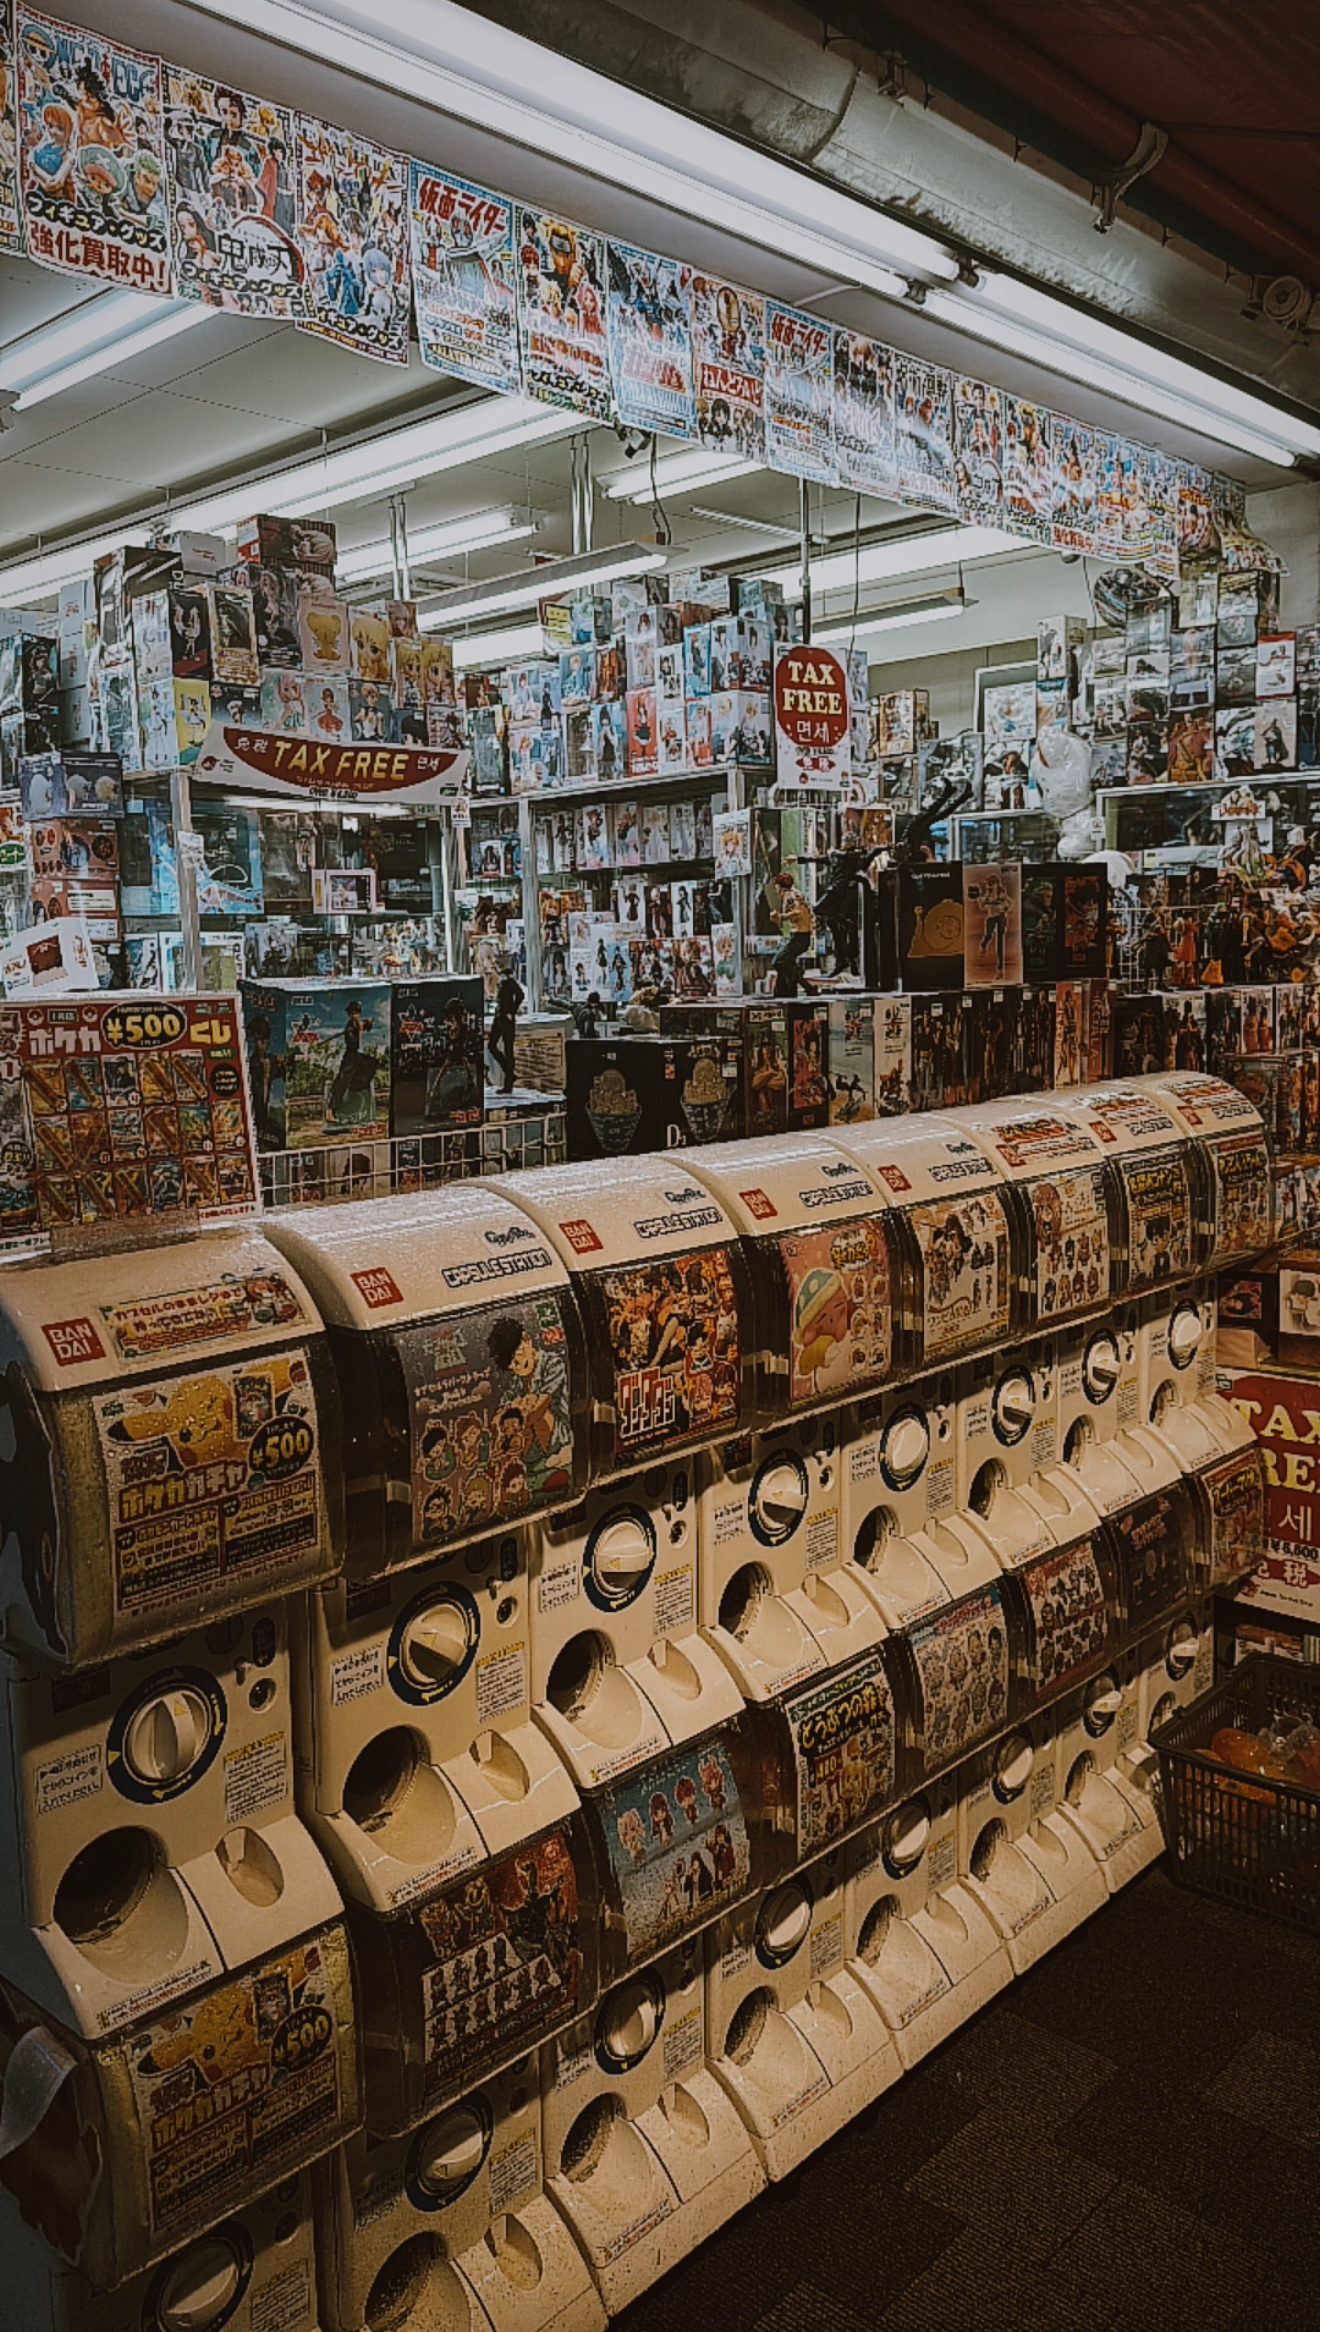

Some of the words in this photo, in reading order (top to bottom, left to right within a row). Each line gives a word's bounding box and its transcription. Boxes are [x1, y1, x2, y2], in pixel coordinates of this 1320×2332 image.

[787, 660, 836, 686] TAX
[782, 687, 842, 715] FREE
[273, 740, 331, 777] TAX
[335, 751, 410, 781] FREE
[29, 1026, 101, 1056] ポケカ
[106, 1013, 181, 1045] ¥500
[357, 1273, 391, 1291] BAN
[367, 1286, 392, 1303] DAI
[50, 1323, 93, 1345] BAN
[55, 1341, 92, 1360] DAI
[1229, 1398, 1320, 1444] TAX
[252, 1428, 311, 1469] ¥500
[1262, 1447, 1320, 1494] RE
